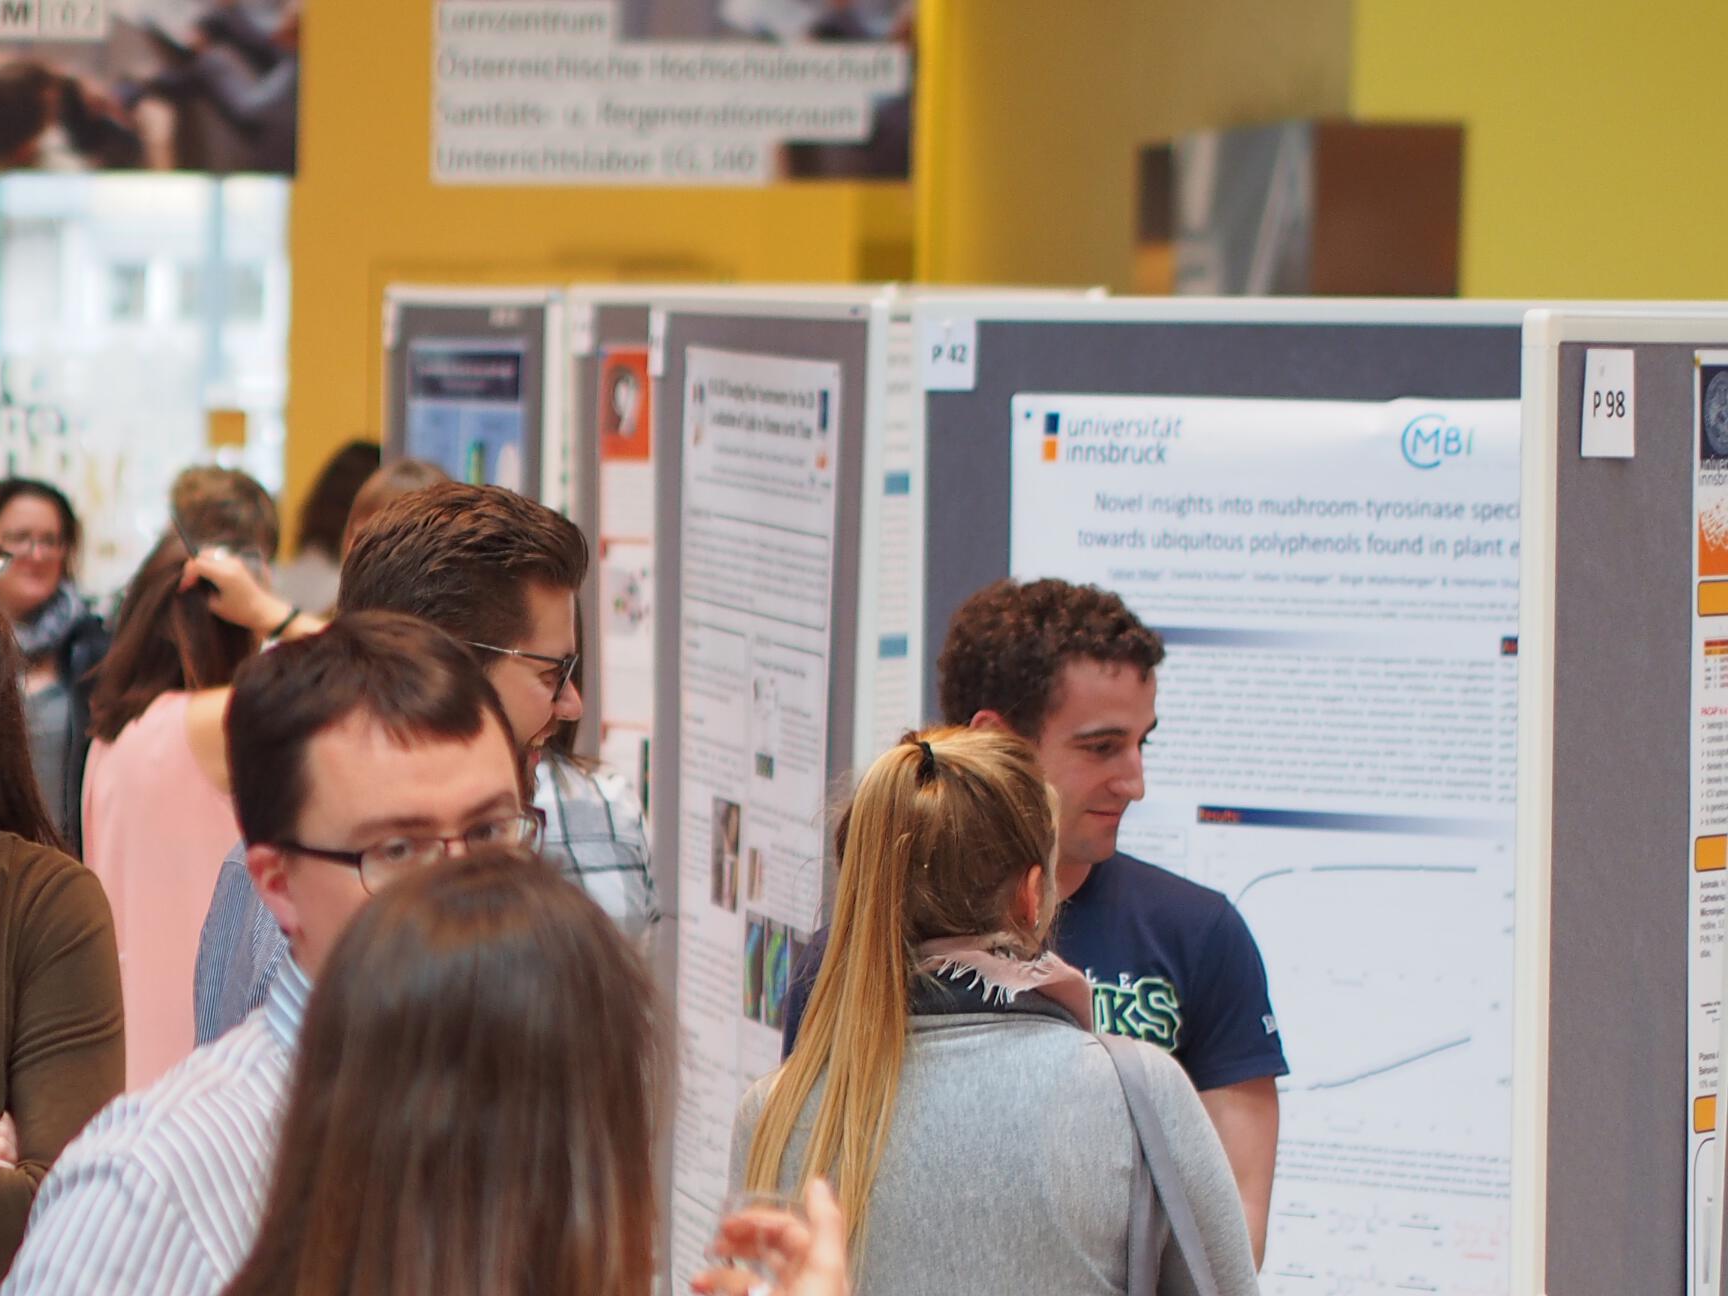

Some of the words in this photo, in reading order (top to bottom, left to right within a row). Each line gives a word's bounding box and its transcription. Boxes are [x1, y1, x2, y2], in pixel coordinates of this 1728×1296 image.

[932, 344, 943, 364] P
[947, 344, 967, 363] 42
[1593, 390, 1601, 418] P
[1606, 390, 1625, 418] 98
[1066, 442, 1167, 465] innsbruck
[1094, 492, 1143, 512] Novel
[1150, 494, 1213, 518] insights
[1219, 496, 1254, 515] into
[1259, 497, 1464, 523] mushroom-tyrosinase
[1078, 530, 1145, 549] towards
[1151, 531, 1244, 554] ubiquitous
[1250, 532, 1361, 559] polyphenols
[1367, 533, 1423, 555] found
[1430, 536, 1446, 555] in
[1453, 536, 1503, 560] plant
